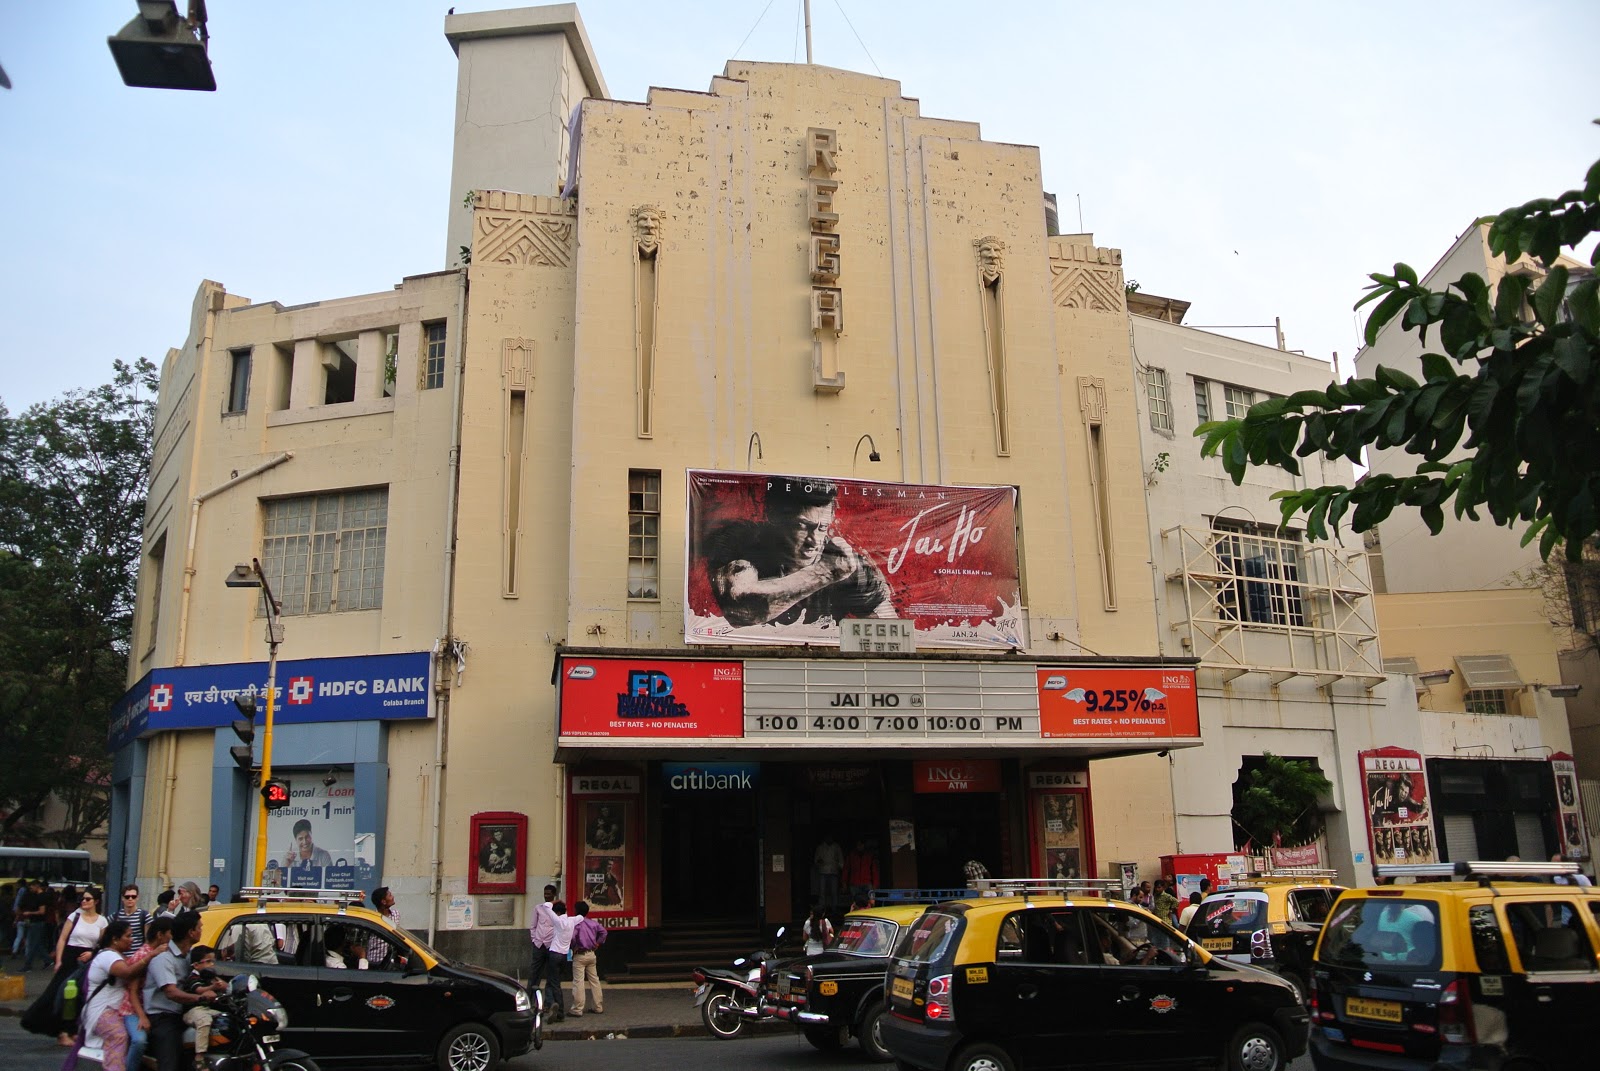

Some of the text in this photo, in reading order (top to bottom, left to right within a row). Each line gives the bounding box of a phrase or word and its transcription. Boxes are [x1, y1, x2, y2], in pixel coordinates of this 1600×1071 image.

[806, 127, 845, 392] REGAL
[767, 482, 882, 497] PEOPLE'S
[897, 490, 945, 499] MAN
[887, 501, 987, 574] Jai Ho
[853, 623, 910, 637] REGAL
[318, 677, 425, 697] HDFC BANK
[628, 670, 674, 698] FD
[383, 698, 425, 707] Colaba Branch
[831, 693, 860, 707] JAI
[872, 694, 900, 707] HO
[1084, 690, 1166, 712] 9.25% p.a.
[756, 715, 1023, 730] 1:00 4:00 7:00 10:00 PM
[1375, 759, 1410, 770] REGAL
[670, 770, 752, 790] citibank
[928, 768, 961, 780] ING
[1036, 775, 1081, 785] REGAL
[579, 779, 632, 790] REGAL
[948, 781, 968, 790] ATM
[328, 787, 355, 797] Loan
[312, 807, 320, 815] in
[322, 801, 331, 819] 1
